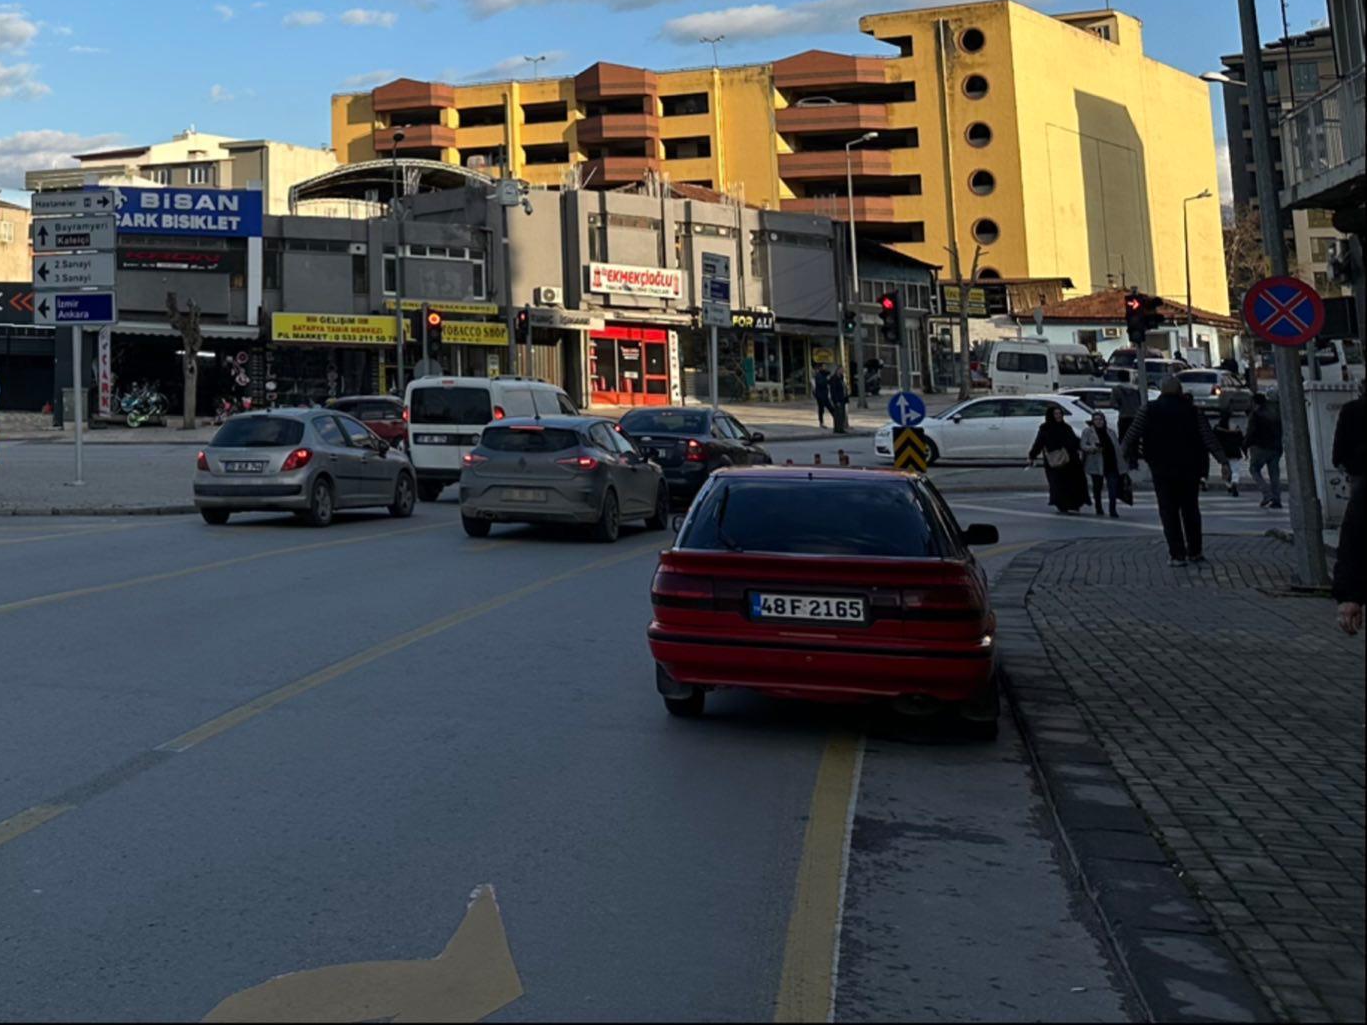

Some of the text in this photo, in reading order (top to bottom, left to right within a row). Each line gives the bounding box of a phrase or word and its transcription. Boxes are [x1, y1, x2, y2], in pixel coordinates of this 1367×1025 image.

[54, 222, 108, 232] Bayramyeri
[607, 269, 673, 287] EKMEKÇİOĞLU
[57, 310, 90, 319] Ankara
[732, 315, 754, 327] FOR
[761, 597, 861, 618] 48 F 2165
